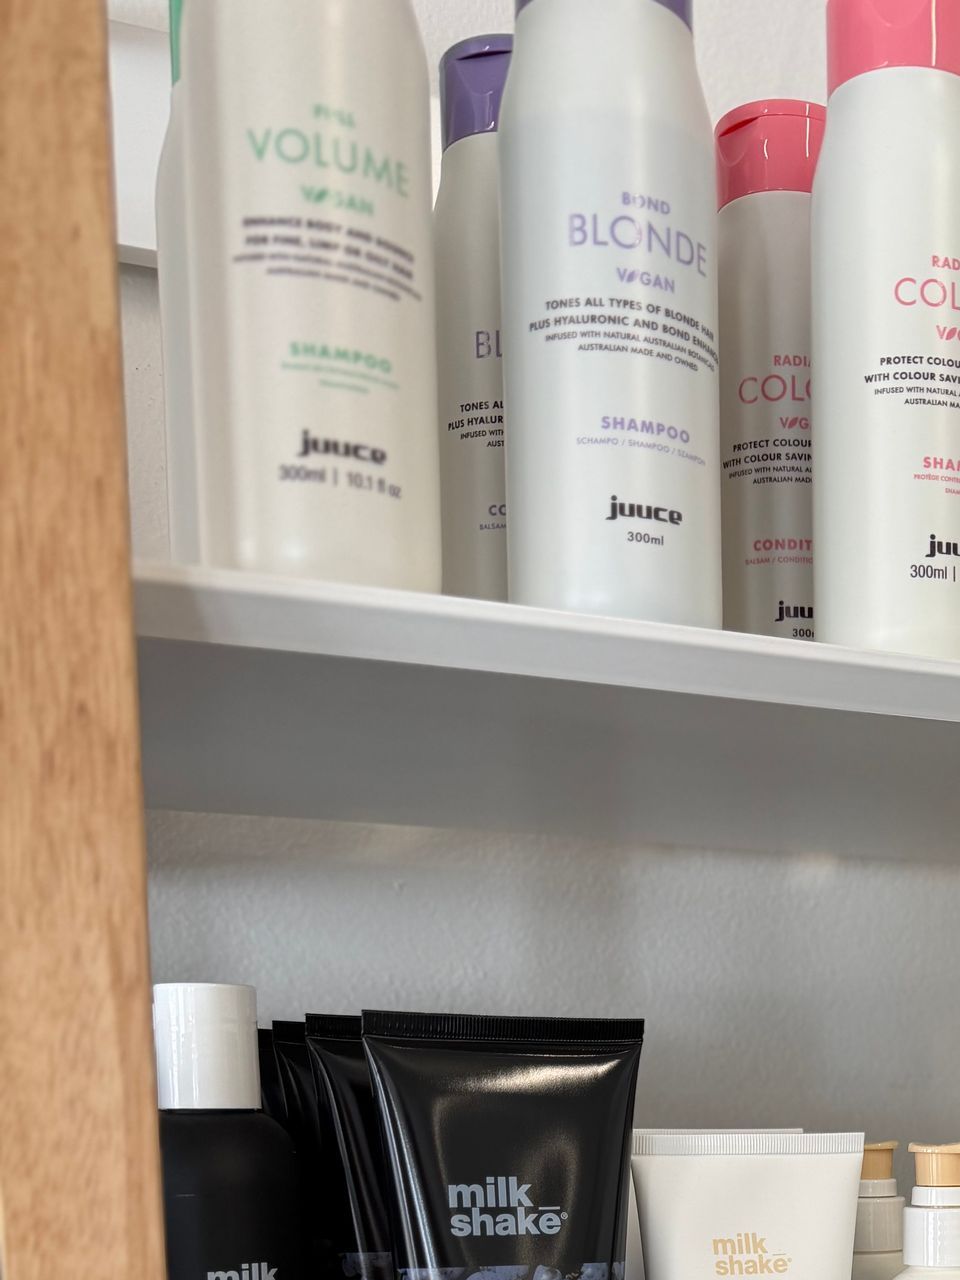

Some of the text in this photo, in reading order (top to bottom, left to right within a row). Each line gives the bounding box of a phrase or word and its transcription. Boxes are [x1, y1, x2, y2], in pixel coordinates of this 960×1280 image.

[246, 127, 409, 198] VOLUME
[622, 191, 672, 216] BOND
[568, 212, 708, 279] BLONDE
[545, 297, 701, 332] TONES ALL TYPES OF BLONDE
[289, 342, 393, 375] SHAMPOO
[880, 355, 924, 367] PROTECT
[600, 415, 691, 445] SHAMPOO
[298, 429, 388, 465] juuce
[733, 440, 770, 453] PROTECT
[605, 494, 684, 526] juuce
[626, 530, 666, 547] 300ml
[909, 563, 949, 581] 300ml
[447, 1176, 535, 1208] milk
[449, 1207, 562, 1237] shake
[712, 1231, 769, 1256] milk
[714, 1254, 788, 1277] shake
